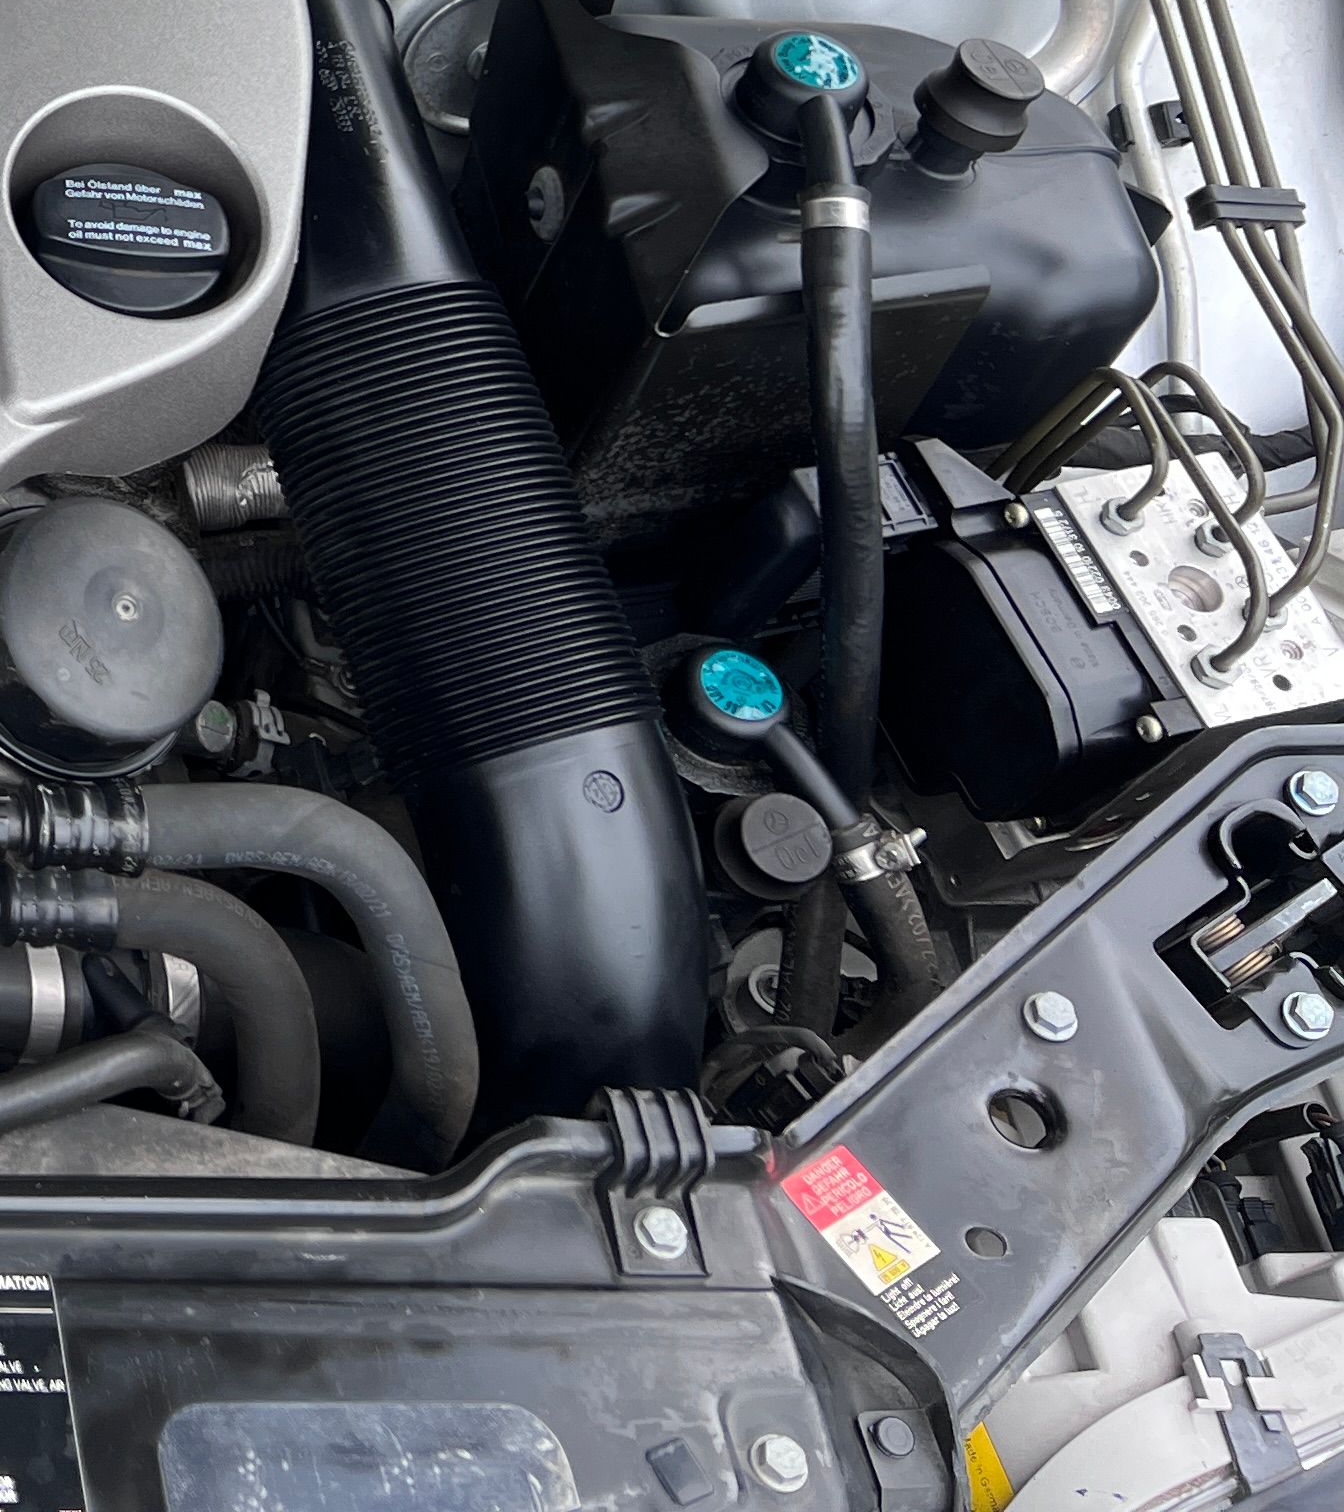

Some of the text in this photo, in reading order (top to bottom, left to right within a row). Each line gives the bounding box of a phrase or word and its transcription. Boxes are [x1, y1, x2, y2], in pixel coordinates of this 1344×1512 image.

[65, 180, 85, 189] Bei
[173, 189, 202, 199] max
[65, 189, 103, 200] Gefahr
[105, 192, 125, 201] von
[68, 219, 211, 241] To avoid damage to engine
[68, 229, 212, 251] oil must not exceed max
[802, 1155, 842, 1185] DANGER
[812, 1168, 851, 1196] GEFAHR
[820, 1172, 868, 1206] PERICOLO
[830, 1187, 872, 1217] PELIGRO
[880, 1287, 901, 1303] Light
[889, 1296, 909, 1311] Licht
